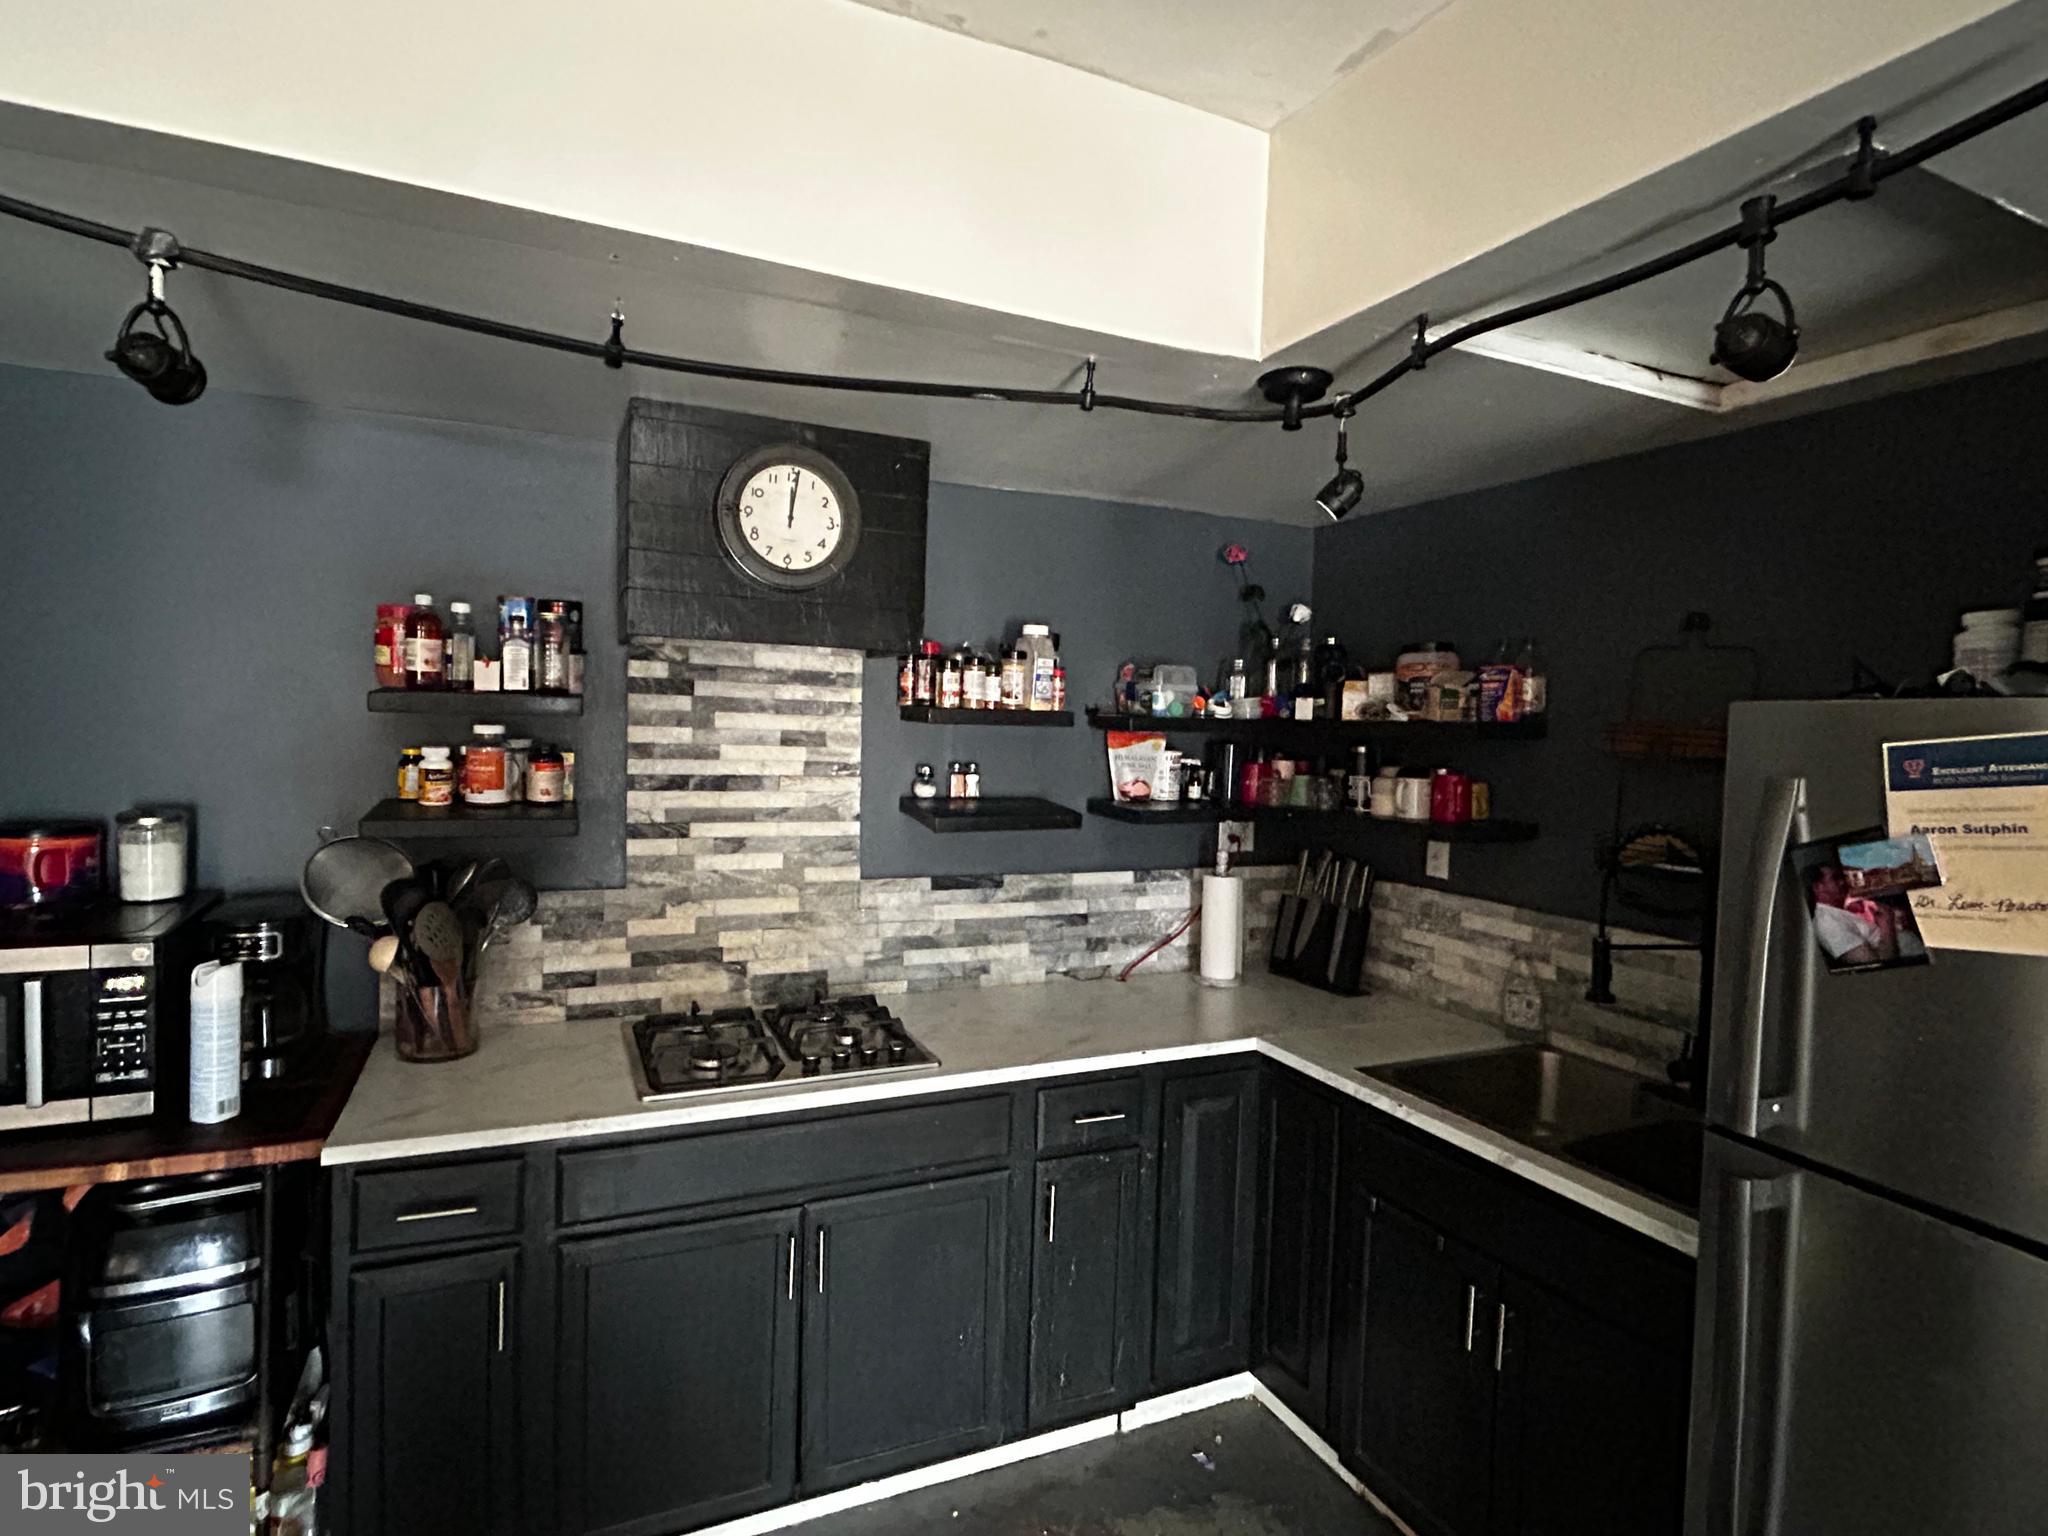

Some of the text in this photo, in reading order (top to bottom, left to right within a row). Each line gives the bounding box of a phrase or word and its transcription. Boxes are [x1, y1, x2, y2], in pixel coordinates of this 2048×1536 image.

[769, 473, 778, 484] 11
[751, 487, 764, 498] 10
[822, 497, 829, 508] 2
[744, 506, 753, 517] 9
[826, 517, 835, 530] 3
[750, 527, 759, 541] 8
[817, 538, 826, 549] 4
[766, 546, 773, 556] 7
[804, 551, 812, 562] 5
[783, 554, 792, 565] 6
[1910, 822, 2029, 836] Aaron Sutphin
